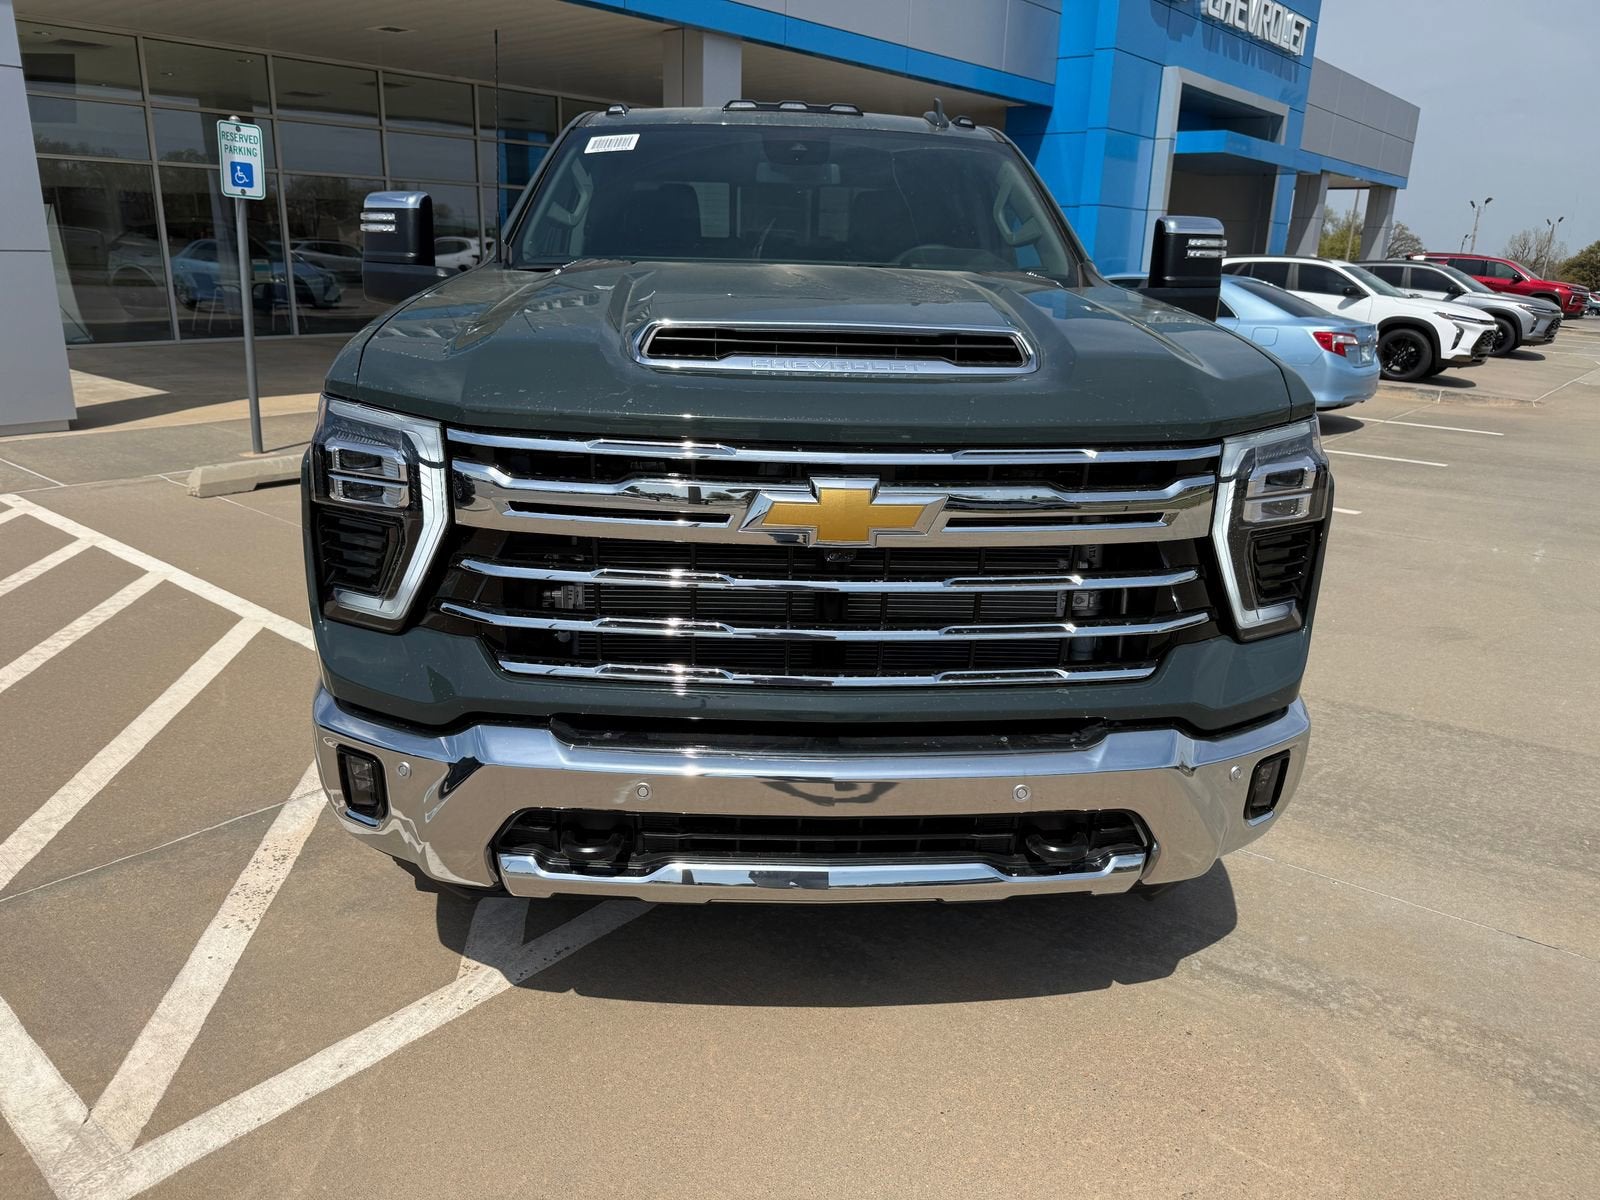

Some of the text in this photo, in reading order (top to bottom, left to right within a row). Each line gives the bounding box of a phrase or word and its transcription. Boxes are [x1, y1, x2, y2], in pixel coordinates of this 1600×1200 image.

[221, 131, 259, 144] RESERVED
[224, 144, 257, 157] PARKING
[751, 359, 925, 371] CHEVROLET
